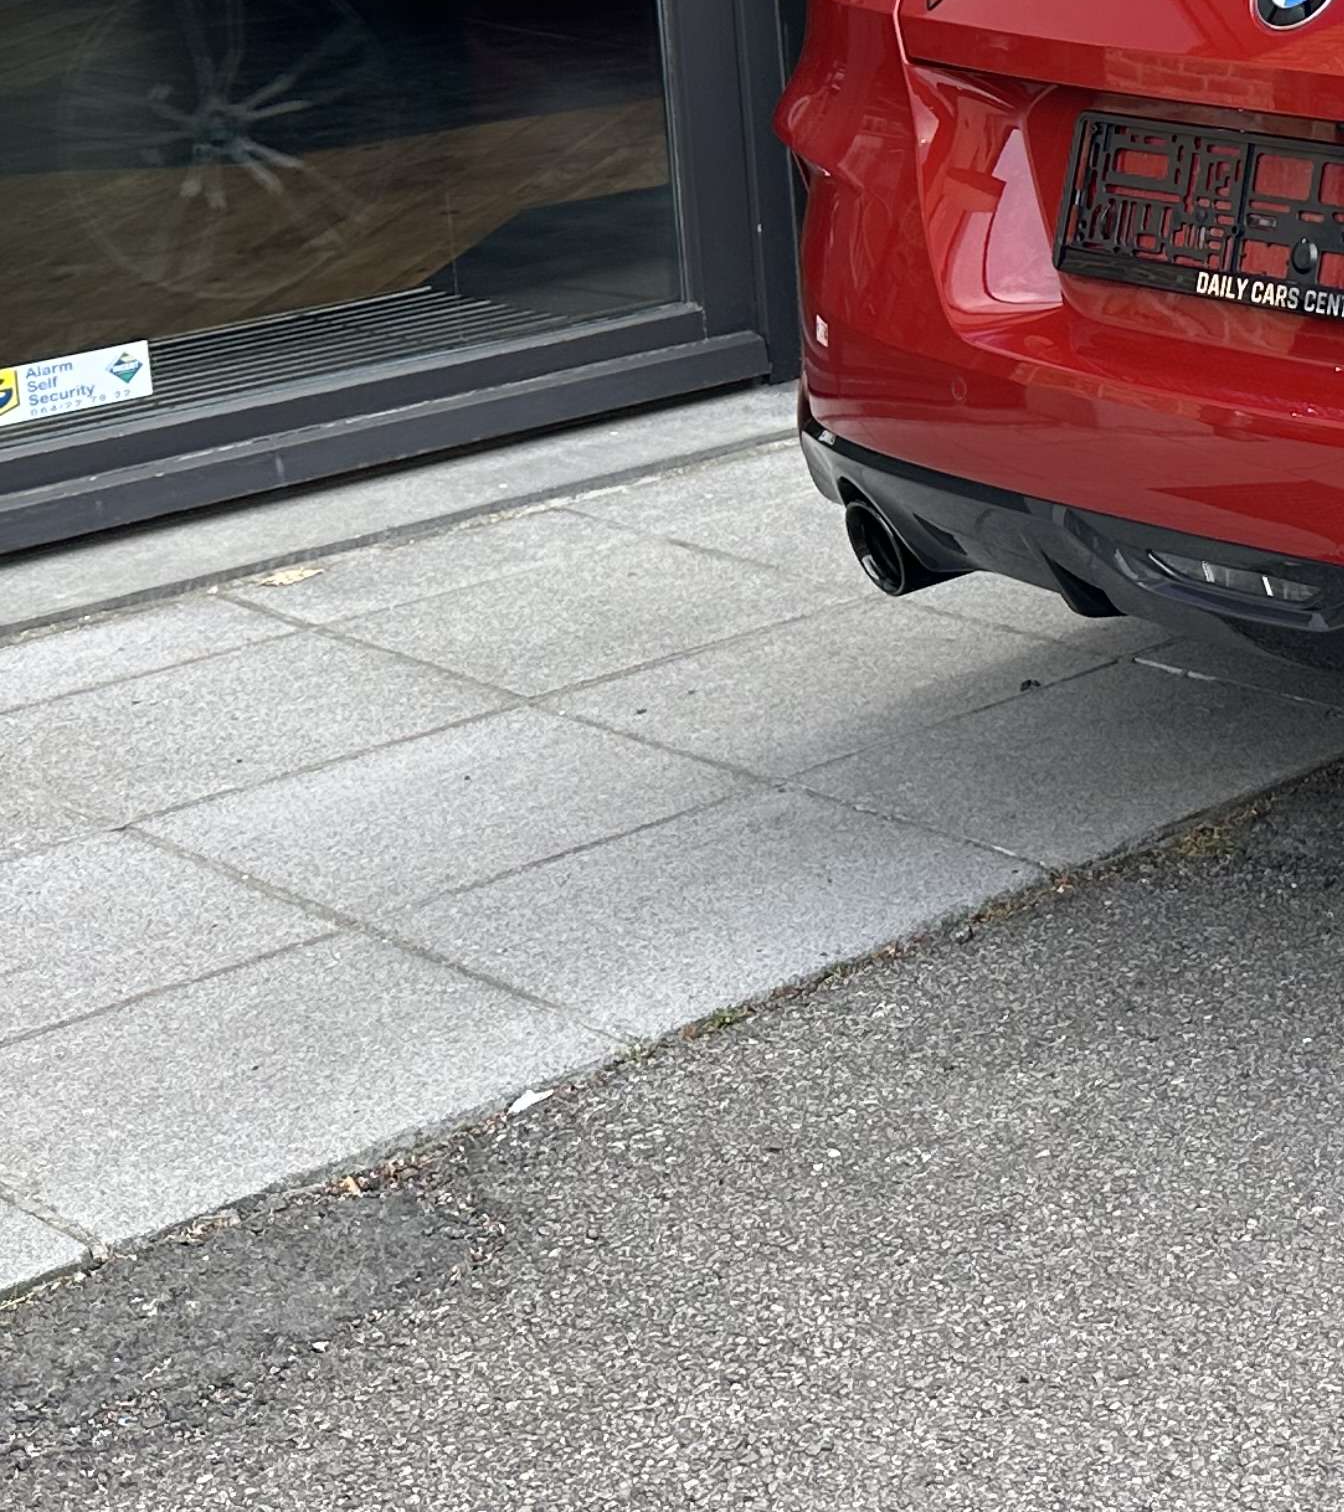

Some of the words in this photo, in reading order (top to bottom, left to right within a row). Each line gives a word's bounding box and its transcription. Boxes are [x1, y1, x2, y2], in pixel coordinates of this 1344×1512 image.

[1196, 271, 1249, 300] DAILY
[1251, 281, 1300, 309] CARS
[26, 361, 74, 379] Alarm
[27, 376, 58, 393] Self
[28, 385, 96, 407] Security
